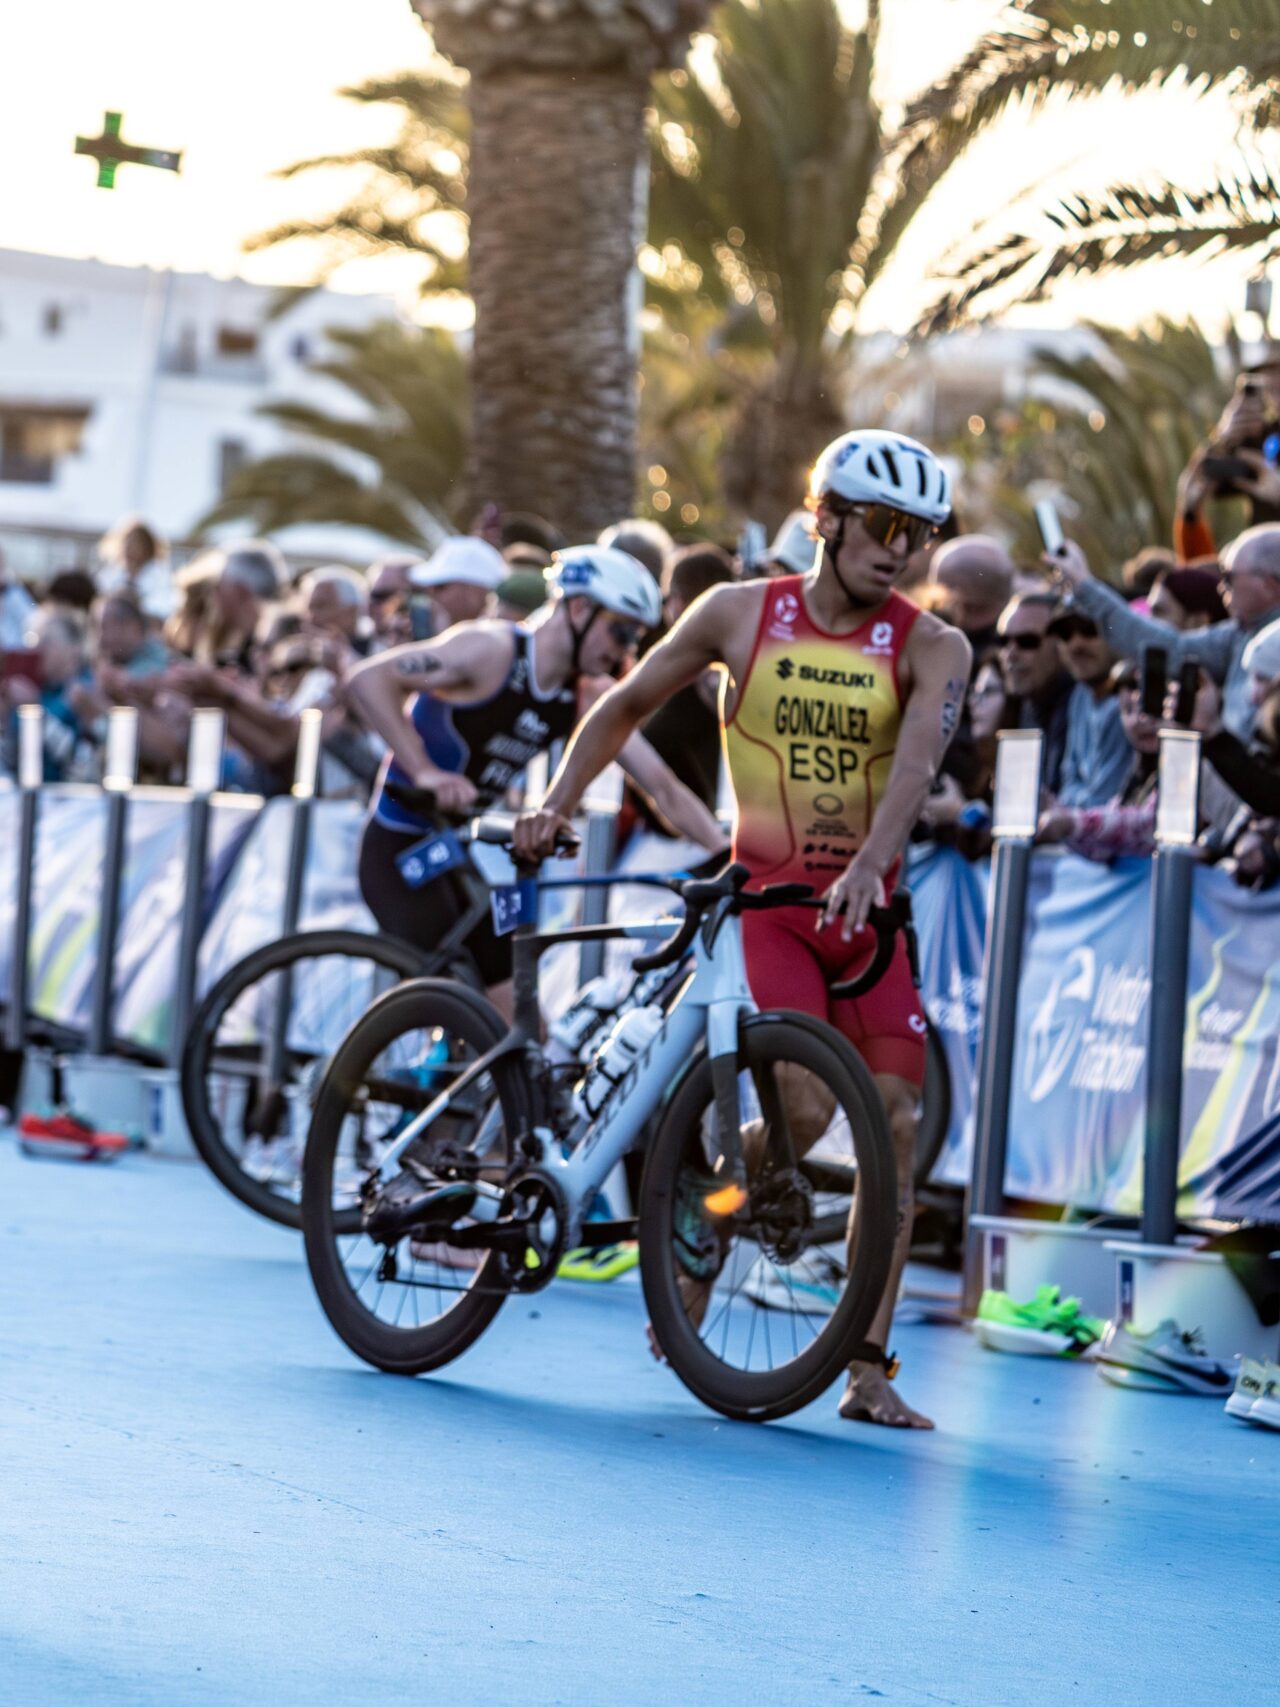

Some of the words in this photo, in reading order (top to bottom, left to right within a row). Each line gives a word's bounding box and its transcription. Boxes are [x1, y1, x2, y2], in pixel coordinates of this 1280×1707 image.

[798, 665, 875, 688] SUZUKI
[775, 695, 871, 744] GONZALEZ
[789, 742, 859, 785] ESP
